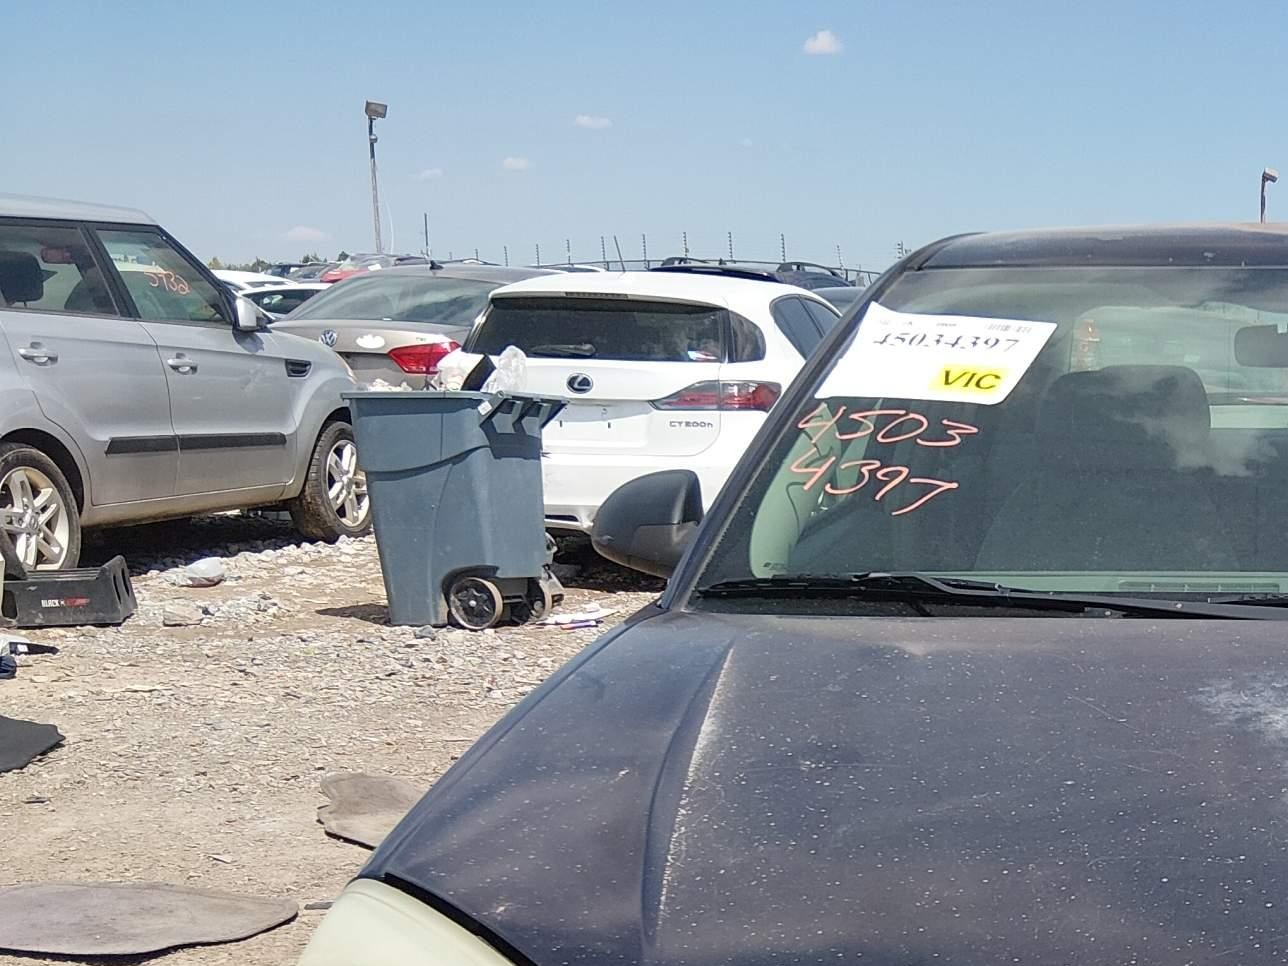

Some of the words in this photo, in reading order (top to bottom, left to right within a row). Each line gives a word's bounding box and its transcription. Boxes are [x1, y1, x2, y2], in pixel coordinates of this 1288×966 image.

[943, 369, 1001, 390] VIC
[797, 404, 979, 447] 4503
[789, 446, 960, 516] 4397
